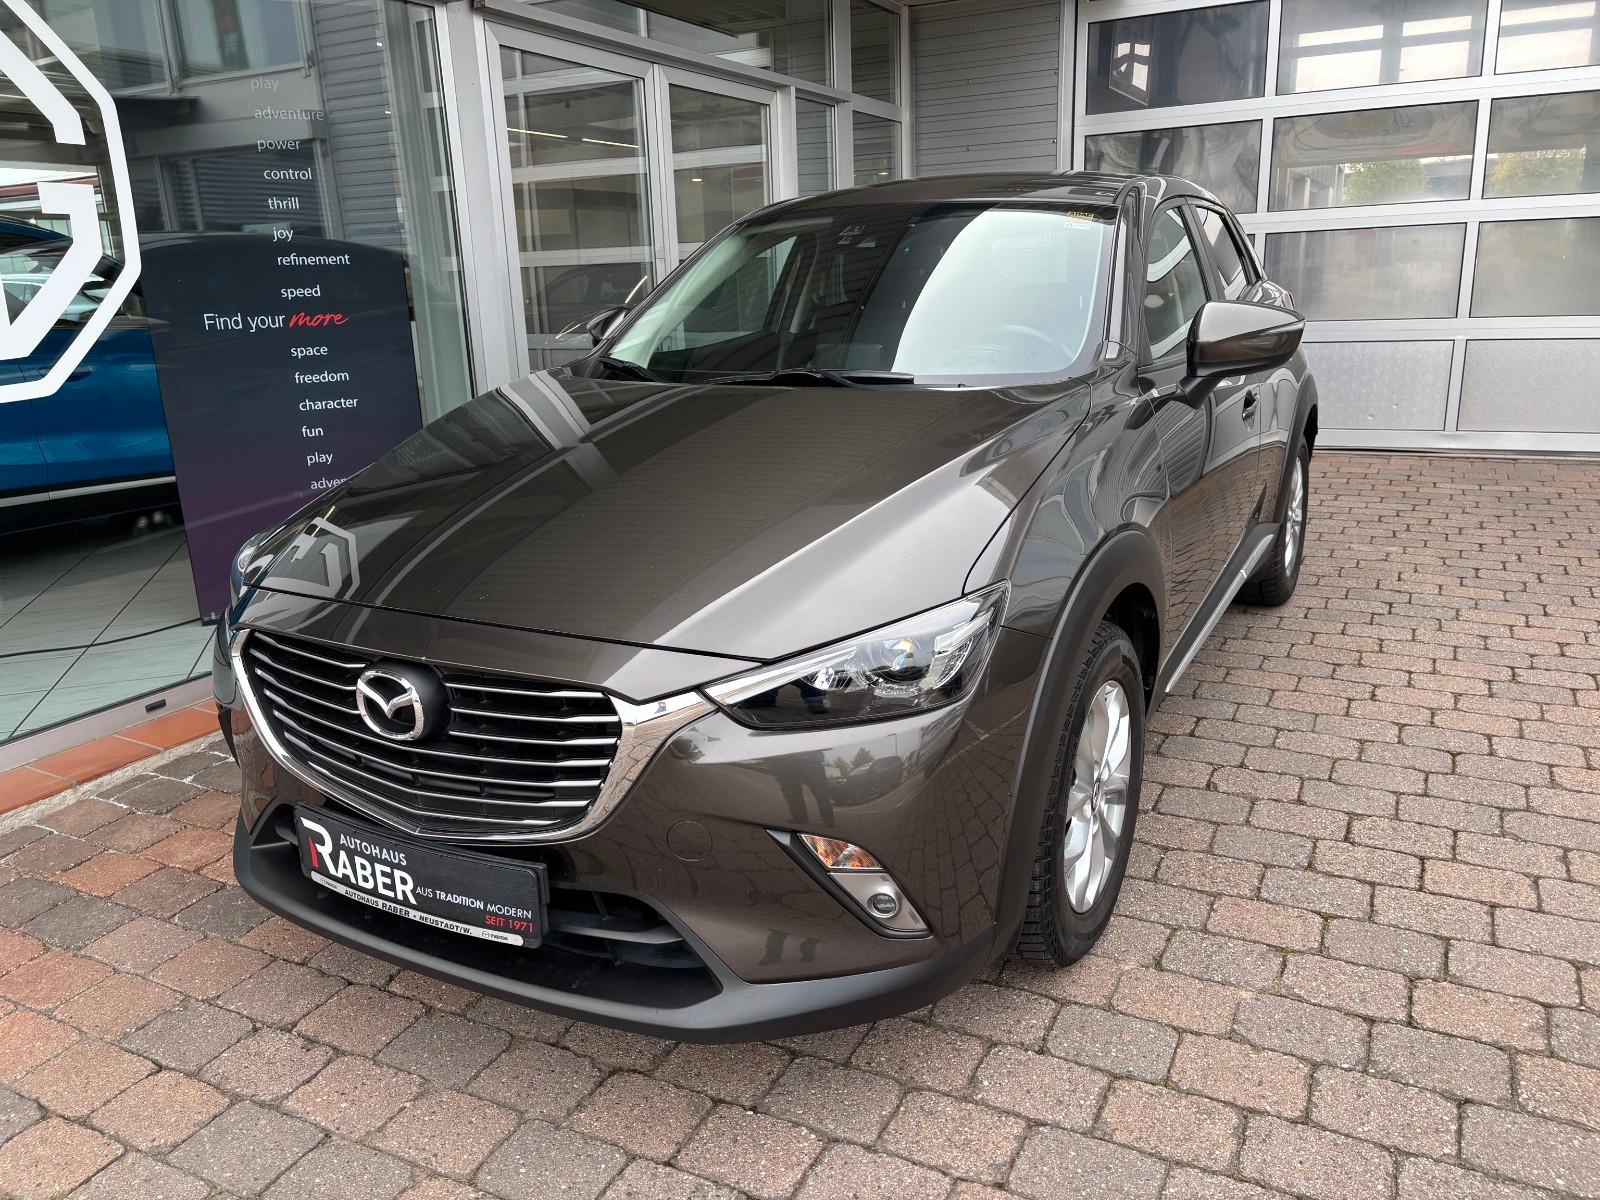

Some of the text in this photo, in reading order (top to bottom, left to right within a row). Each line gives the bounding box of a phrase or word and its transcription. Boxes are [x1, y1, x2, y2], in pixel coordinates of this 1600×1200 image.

[250, 77, 280, 92] play
[254, 107, 324, 121] adventure
[256, 138, 301, 152] power
[263, 168, 313, 180] control
[267, 197, 300, 210] thrill
[273, 227, 294, 242] joy
[277, 252, 351, 266] refinement
[280, 284, 321, 300] speed
[203, 311, 350, 333] Find your more
[290, 346, 328, 358] space
[294, 370, 350, 384] freedom
[299, 397, 358, 411] character
[301, 425, 324, 438] fun
[306, 452, 333, 467] play
[339, 833, 407, 866] AUTOHAUS
[300, 816, 418, 905] RABER
[416, 886, 532, 919] AUS TRADITION MODERN
[344, 888, 380, 907] AUTOHAUS
[382, 902, 410, 918] RABER
[419, 914, 473, 935] NEUSTADT/W.
[485, 914, 534, 933] SEIT 1971
